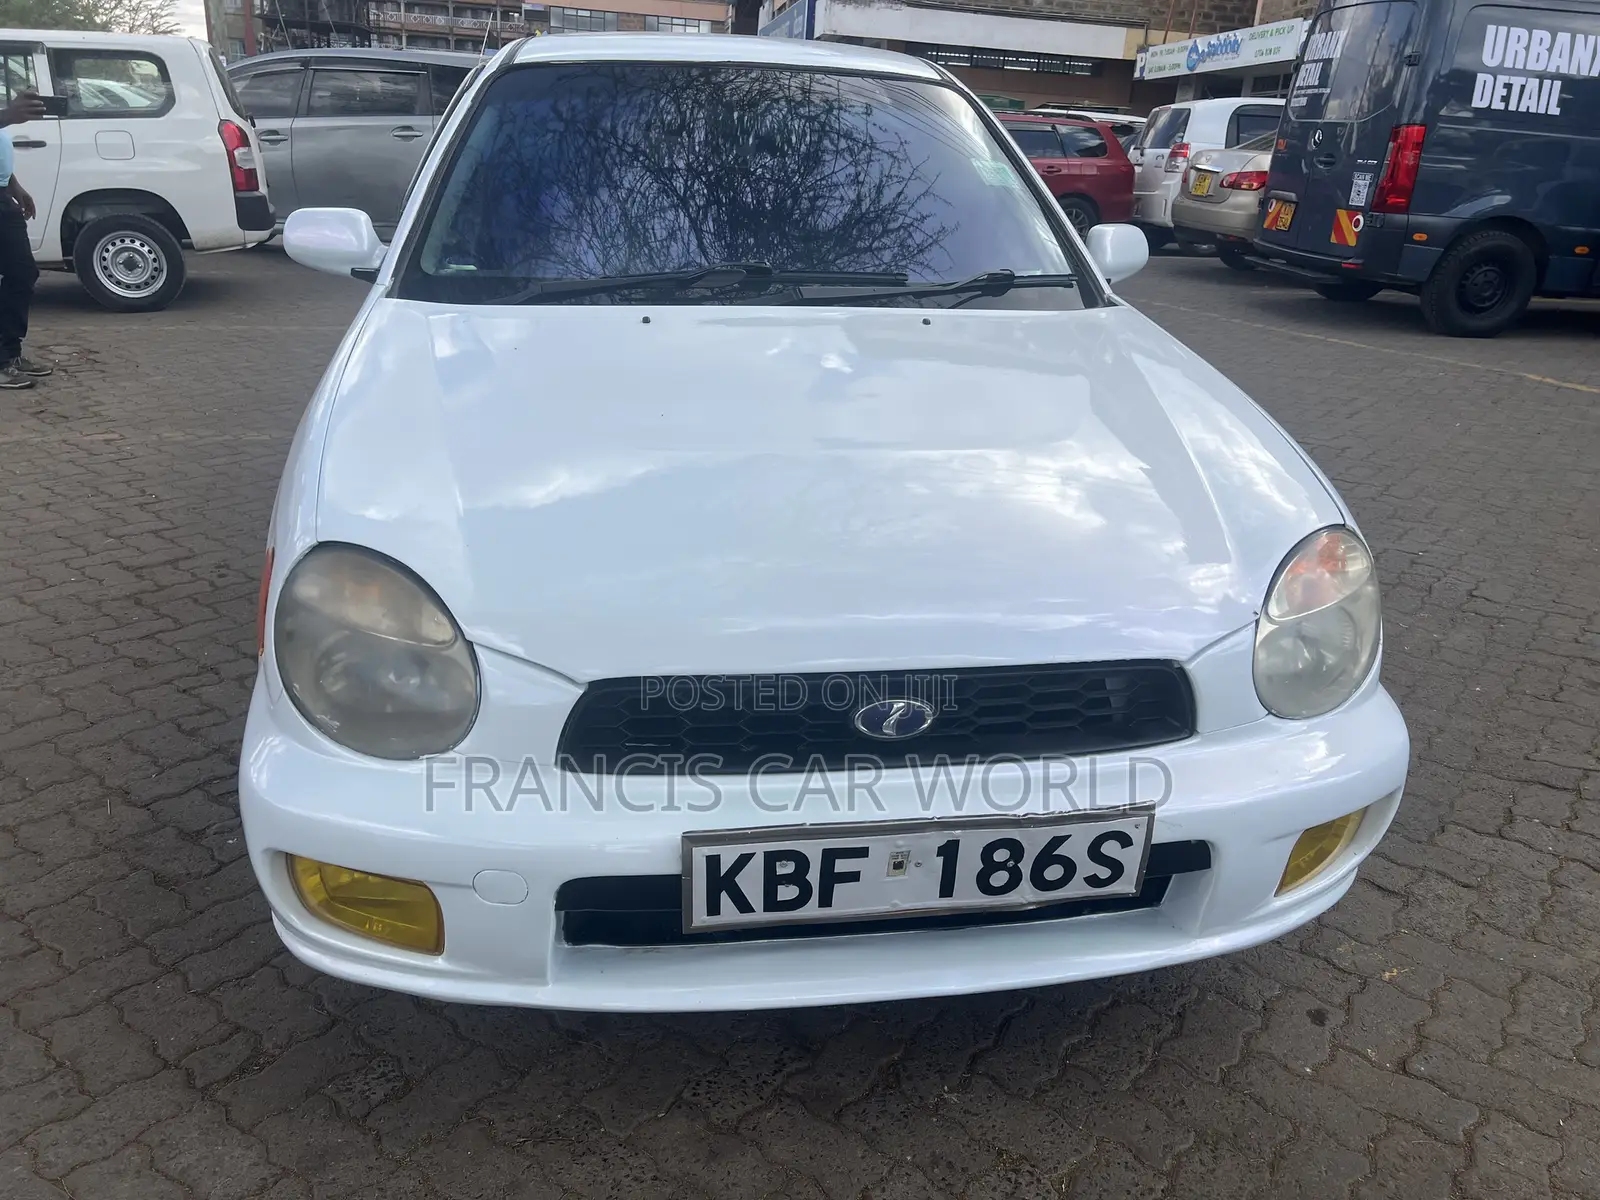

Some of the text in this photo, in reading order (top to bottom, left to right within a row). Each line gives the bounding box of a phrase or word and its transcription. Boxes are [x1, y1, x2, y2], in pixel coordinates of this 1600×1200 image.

[1249, 28, 1269, 41] DELIVERY
[1274, 26, 1287, 37] PICK
[1471, 73, 1562, 115] DETAIL
[705, 830, 1135, 917] KBF 186S
